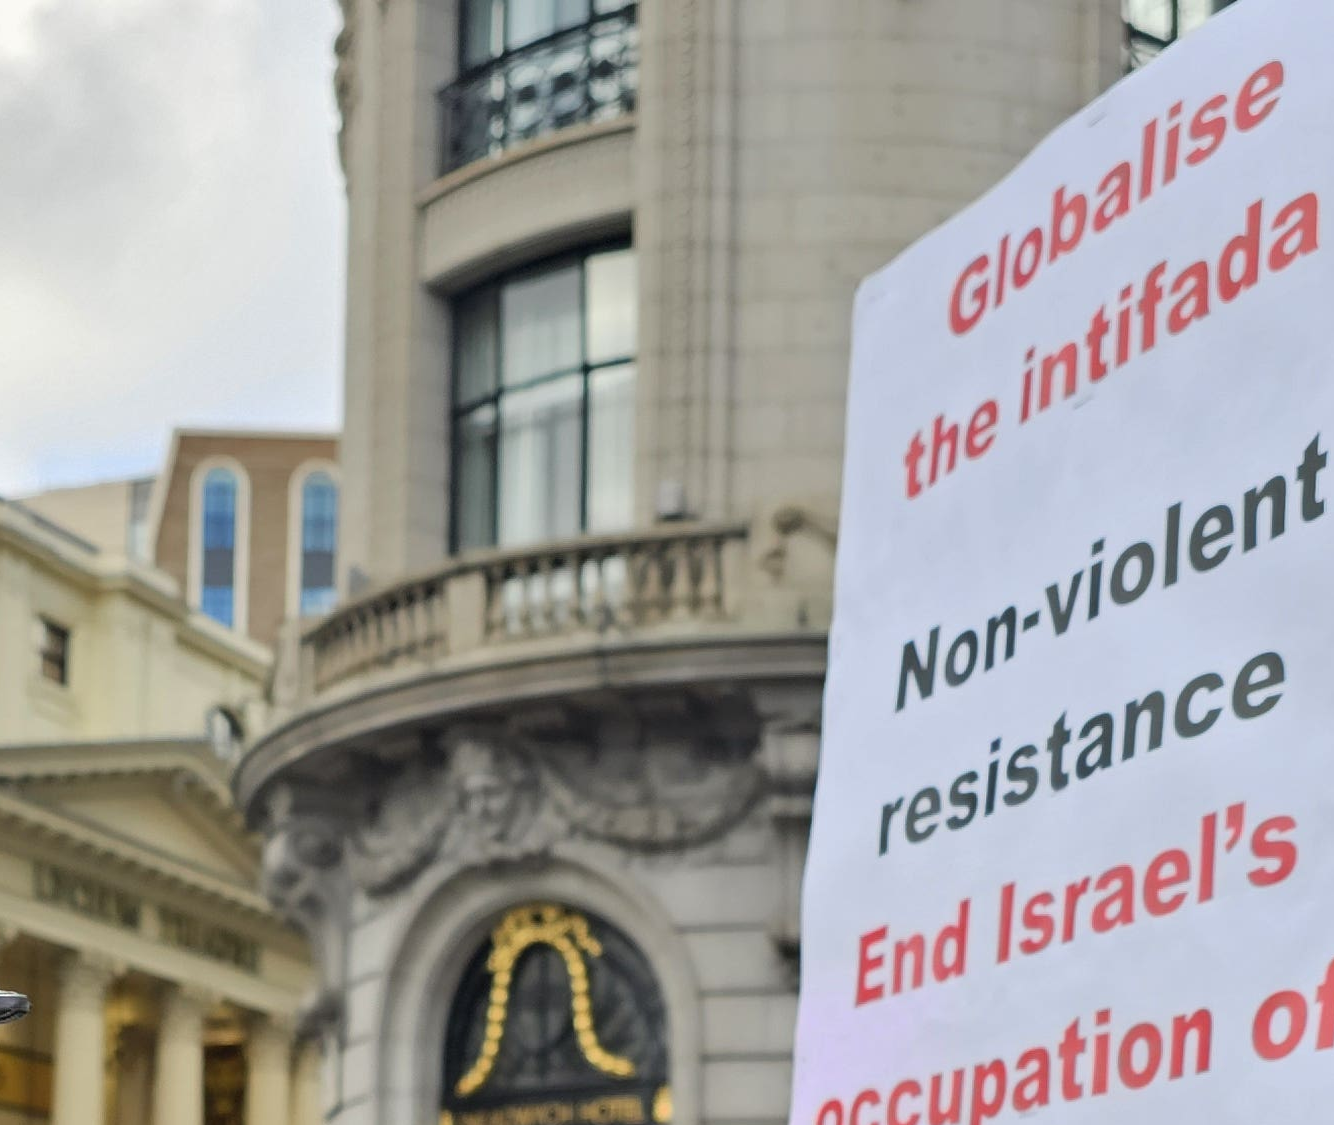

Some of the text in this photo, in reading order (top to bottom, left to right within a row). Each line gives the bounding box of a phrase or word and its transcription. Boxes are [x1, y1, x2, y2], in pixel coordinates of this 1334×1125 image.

[948, 59, 1284, 337] Globalise
[904, 191, 1319, 499] the intifada
[894, 432, 1328, 713] Non-violent
[879, 650, 1286, 856] resistance
[854, 801, 1299, 1008] End Israel’s
